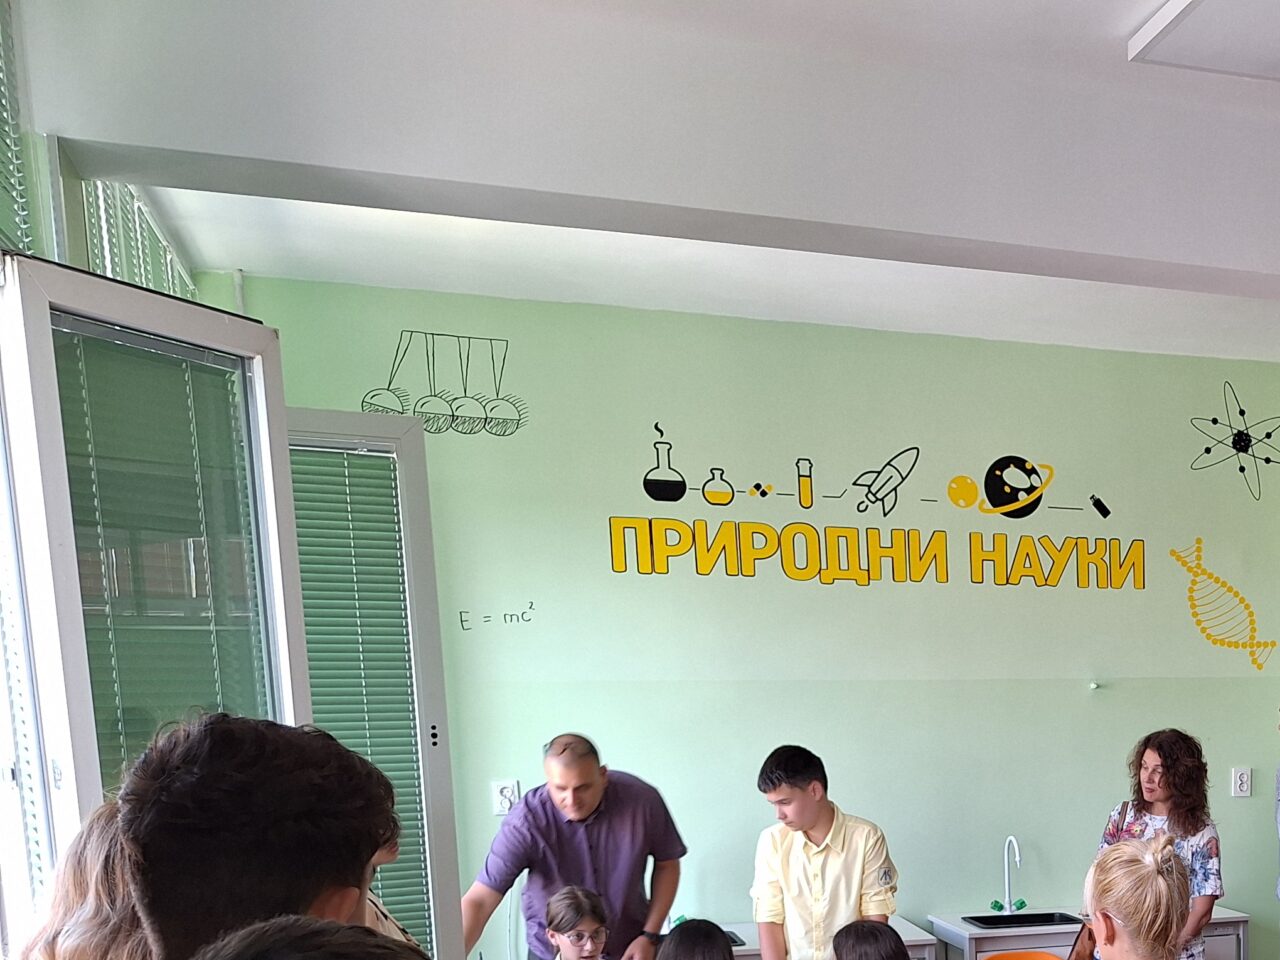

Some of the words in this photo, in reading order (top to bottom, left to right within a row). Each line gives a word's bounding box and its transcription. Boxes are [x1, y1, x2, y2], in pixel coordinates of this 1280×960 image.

[608, 516, 948, 586] ПРИРОДНИ
[969, 531, 1146, 590] НАУКИ
[459, 610, 472, 631] E
